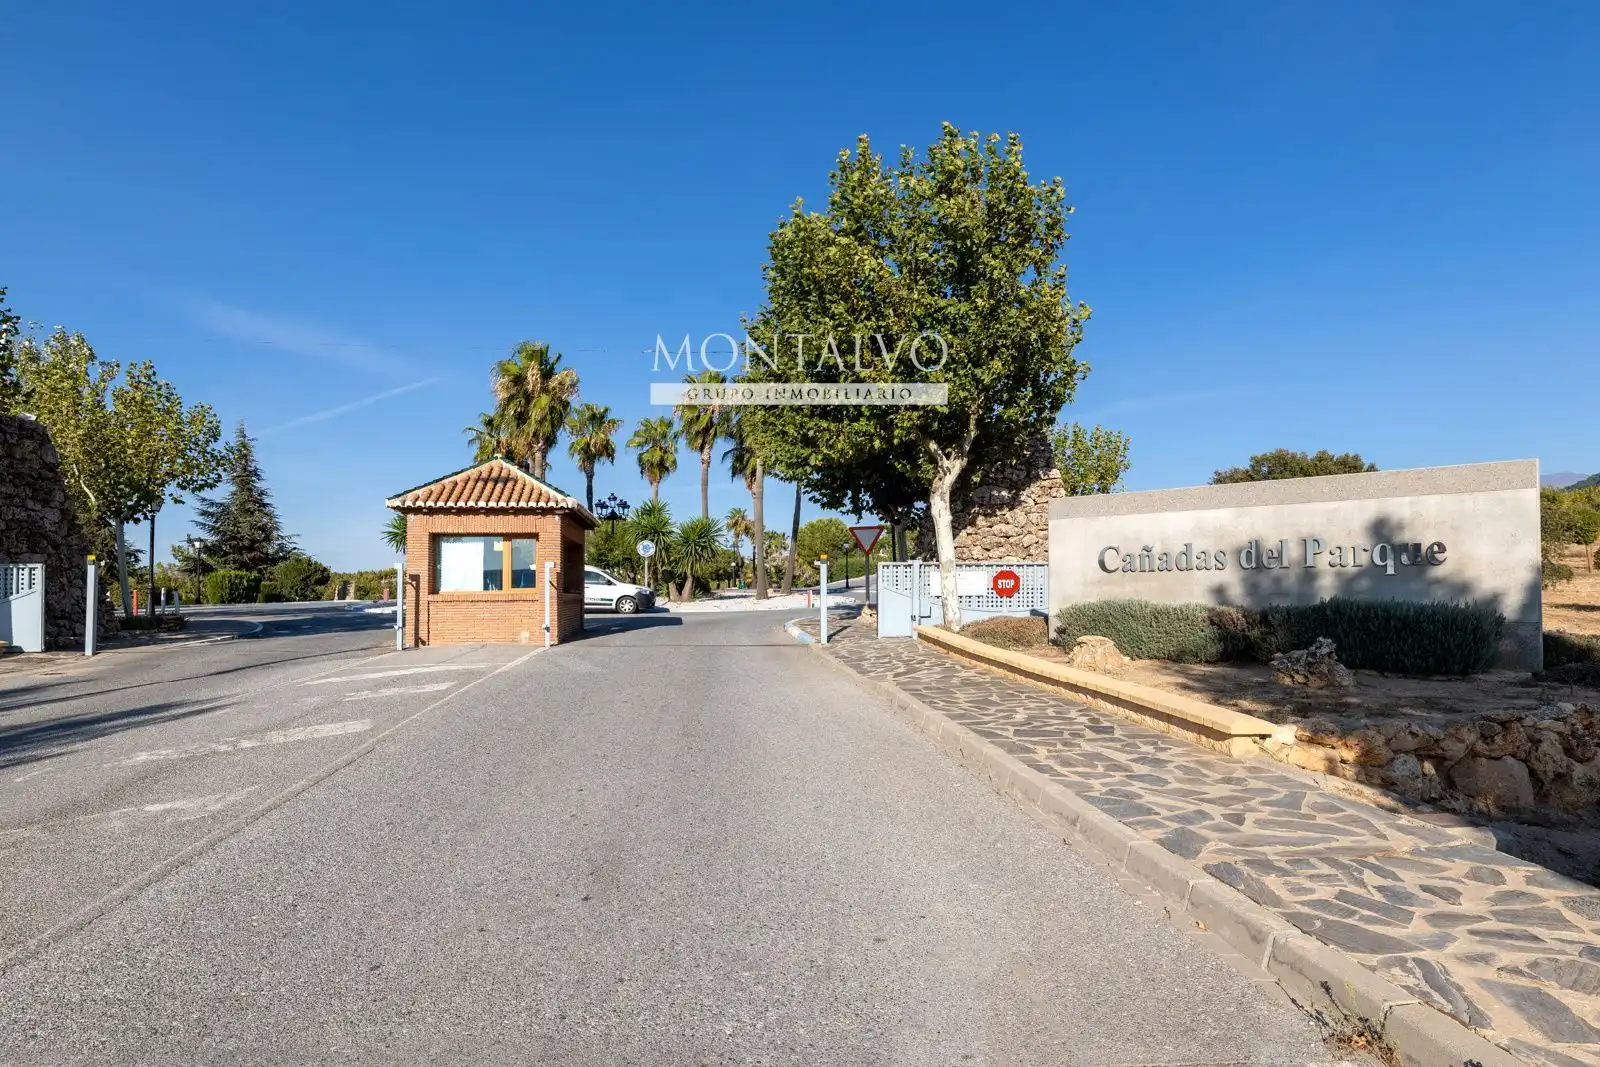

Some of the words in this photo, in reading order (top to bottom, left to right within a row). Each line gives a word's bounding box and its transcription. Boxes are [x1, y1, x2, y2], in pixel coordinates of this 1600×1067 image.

[1098, 542, 1229, 573] Cañadas
[1239, 539, 1290, 569] del
[1302, 536, 1448, 576] Parque
[997, 579, 1015, 589] STOP
